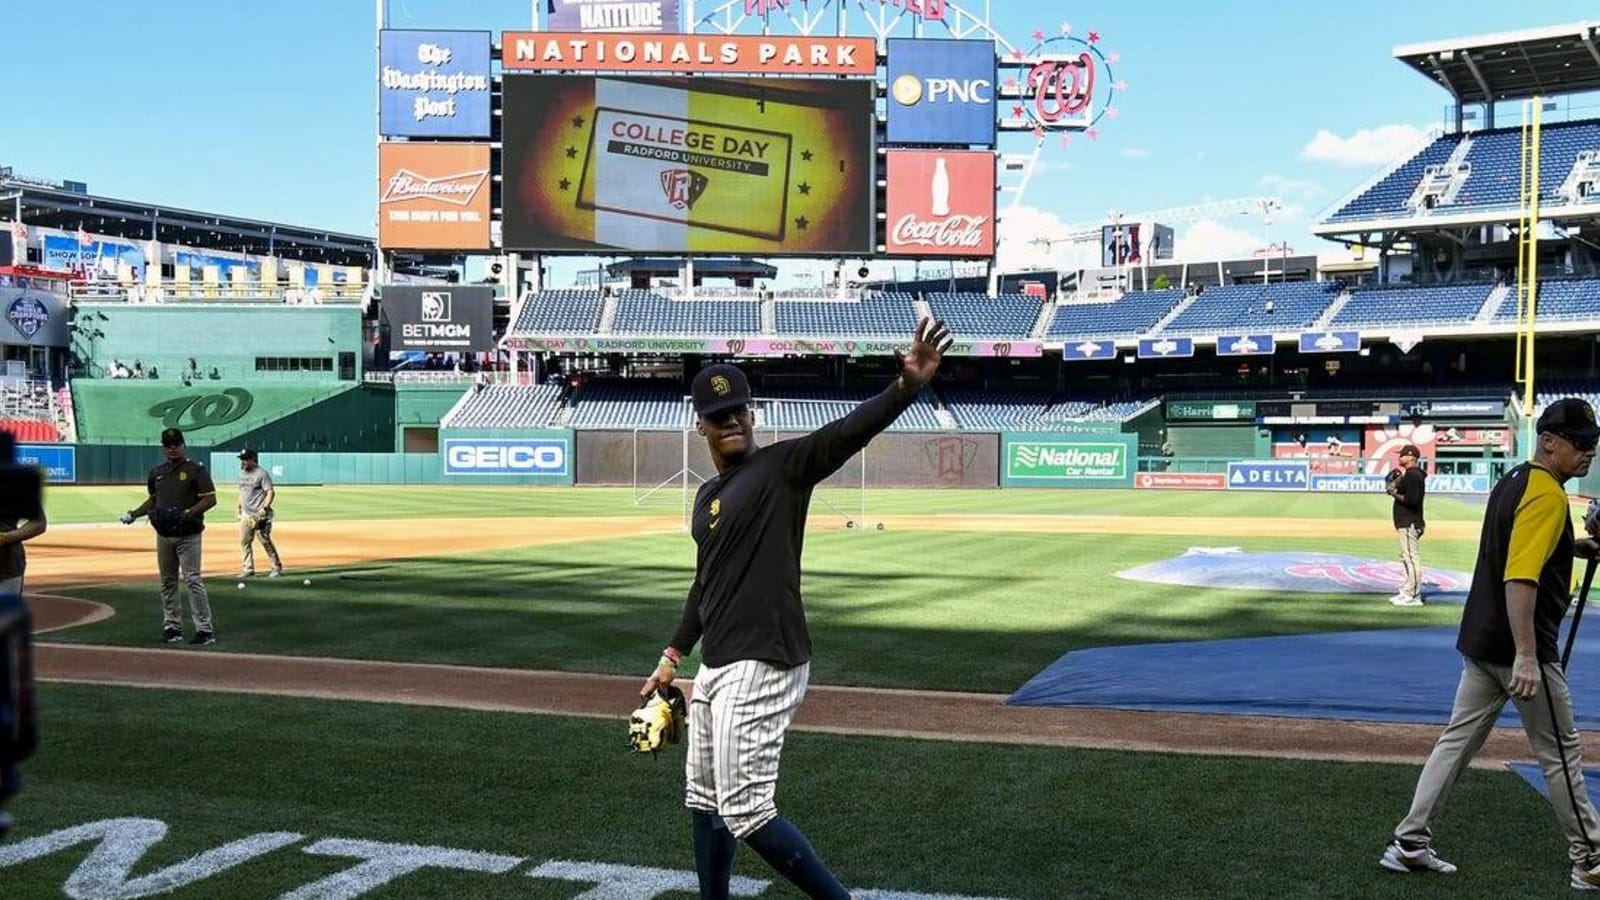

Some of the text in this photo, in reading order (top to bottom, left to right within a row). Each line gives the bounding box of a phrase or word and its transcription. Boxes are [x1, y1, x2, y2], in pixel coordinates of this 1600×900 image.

[580, 2, 663, 28] NATITUDE
[418, 43, 452, 67] The
[514, 39, 857, 66] NATIONALS PARK
[383, 66, 488, 94] Washington
[926, 77, 991, 104] PNC
[413, 96, 456, 121] Post
[611, 120, 770, 159] COLLEGE DAY
[623, 144, 752, 172] RADFORD UNIVERSITY
[389, 175, 477, 196] Budweiser
[402, 324, 471, 337] BETMGM
[597, 340, 705, 350] RADFORD UNIVERSITY
[816, 341, 836, 351] DAY
[448, 446, 564, 469] GEICO
[1038, 447, 1119, 467] National
[1065, 466, 1115, 476] Car Rental
[1249, 470, 1306, 483] DELTA
